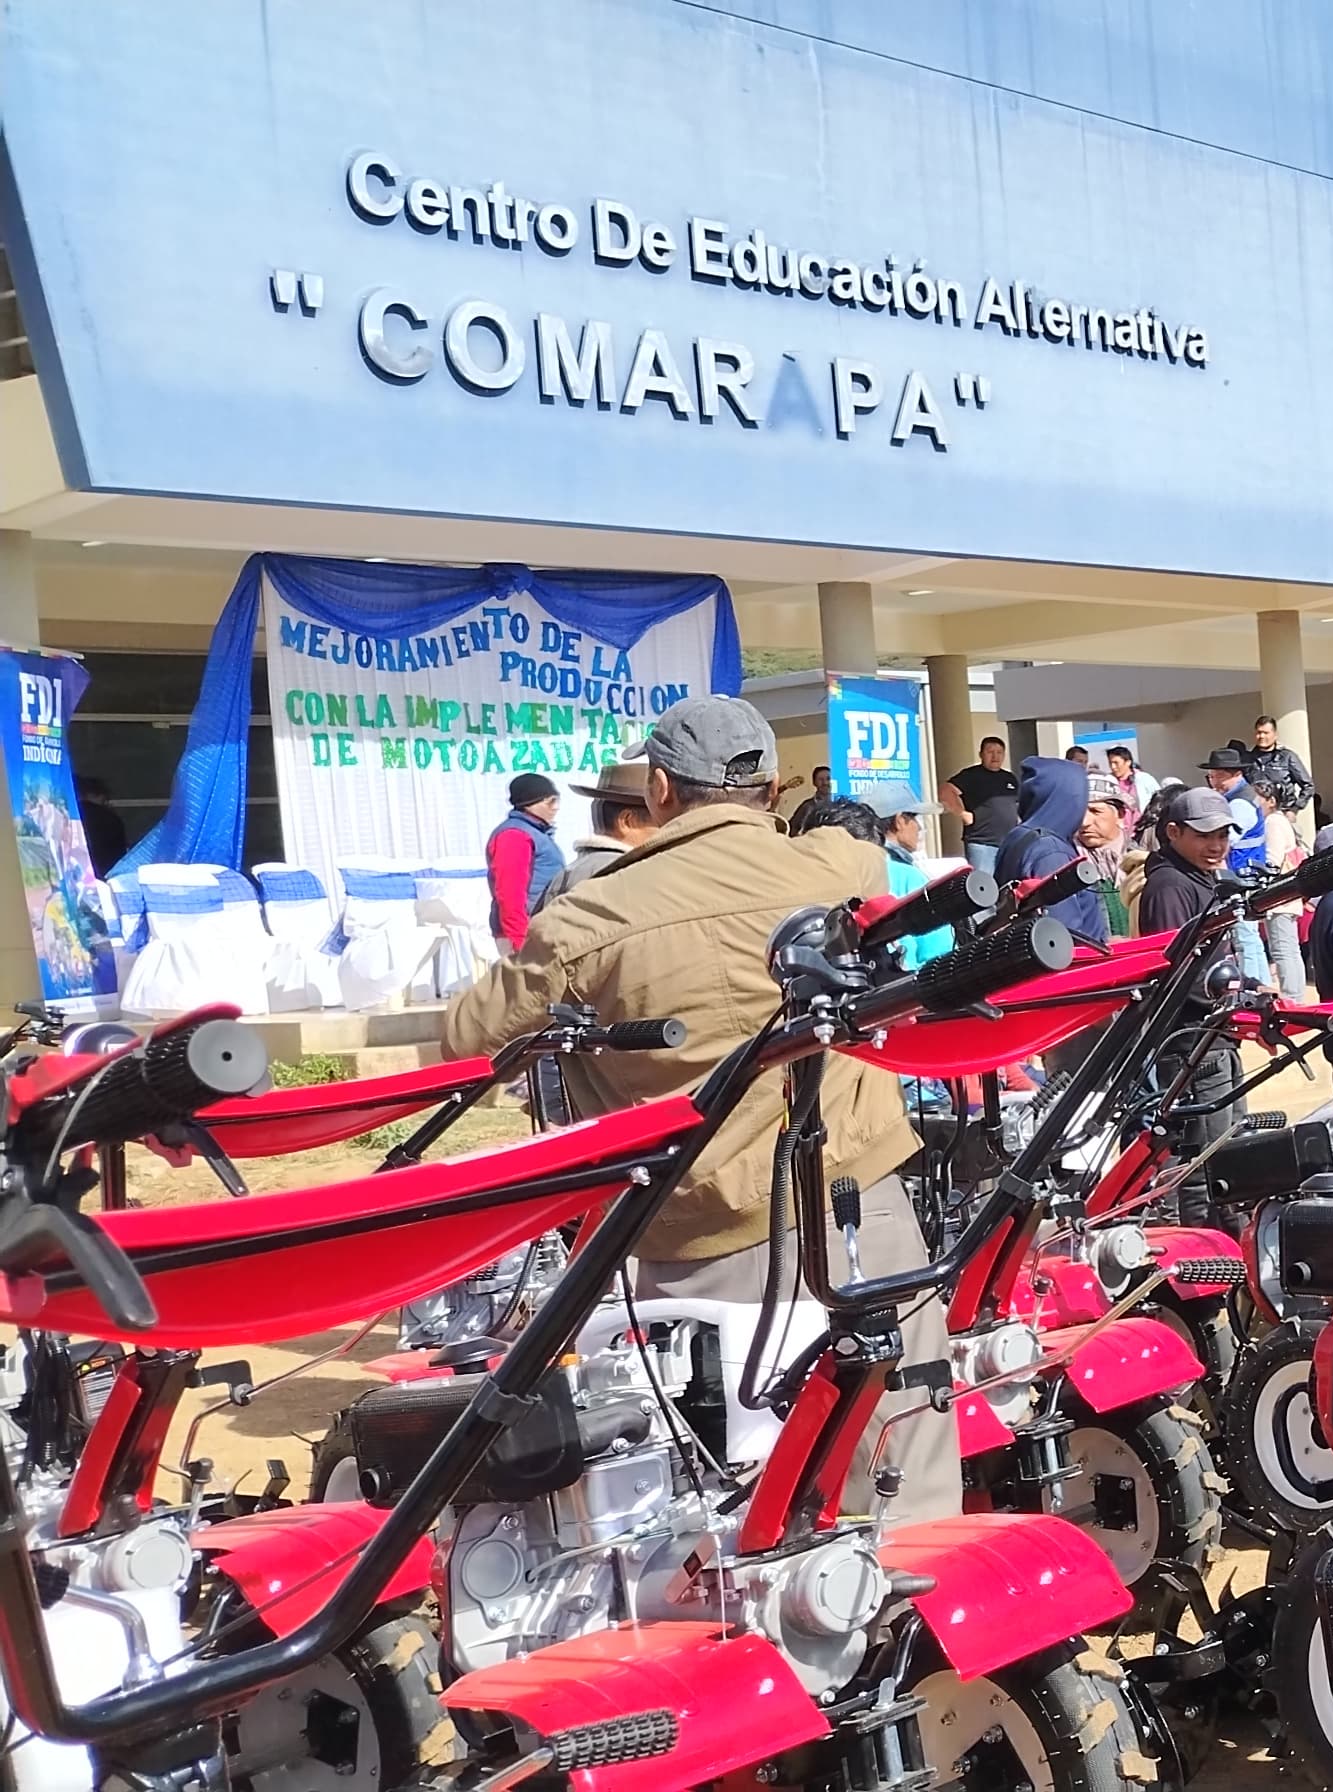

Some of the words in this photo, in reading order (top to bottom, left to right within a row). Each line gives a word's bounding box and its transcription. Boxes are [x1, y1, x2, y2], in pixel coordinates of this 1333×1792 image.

[346, 151, 579, 254] Centro
[591, 196, 678, 271] De
[690, 216, 967, 322] Educación
[974, 279, 1212, 369] Alternativa
[280, 606, 530, 672] MEJORAMIENTO
[540, 621, 582, 664] DE
[592, 646, 633, 683] LA
[19, 672, 62, 727] FDI
[285, 690, 348, 728] CON
[355, 694, 396, 729] LA
[500, 650, 690, 717] PRODUCCION
[312, 733, 358, 767] DE
[382, 737, 619, 775] MOTOAZADAS
[844, 710, 910, 760] FDI
